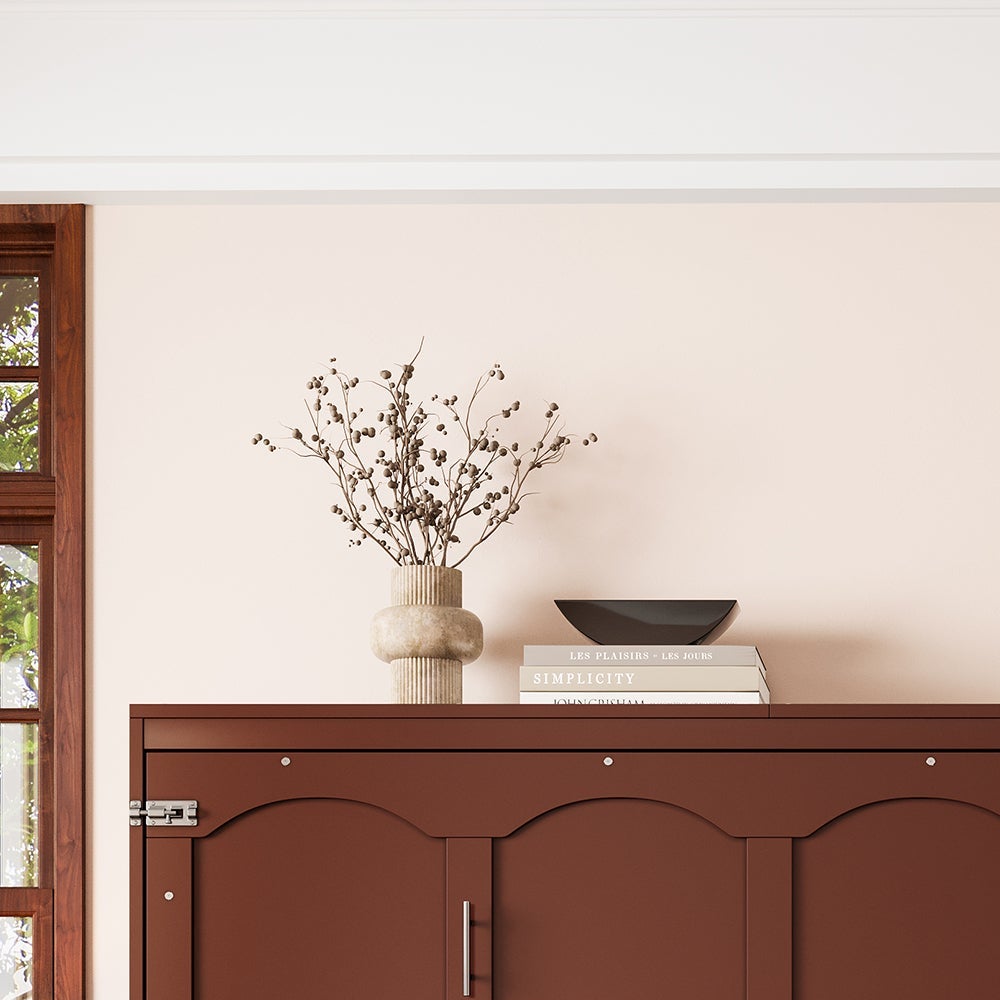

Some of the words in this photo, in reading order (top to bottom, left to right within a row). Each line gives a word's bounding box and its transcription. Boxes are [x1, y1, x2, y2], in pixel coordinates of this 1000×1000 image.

[570, 652, 591, 660] LES
[596, 652, 649, 660] PLAISIRS
[661, 652, 680, 660] LES
[683, 652, 713, 660] JOURS
[533, 673, 635, 685] SIMPLICITY
